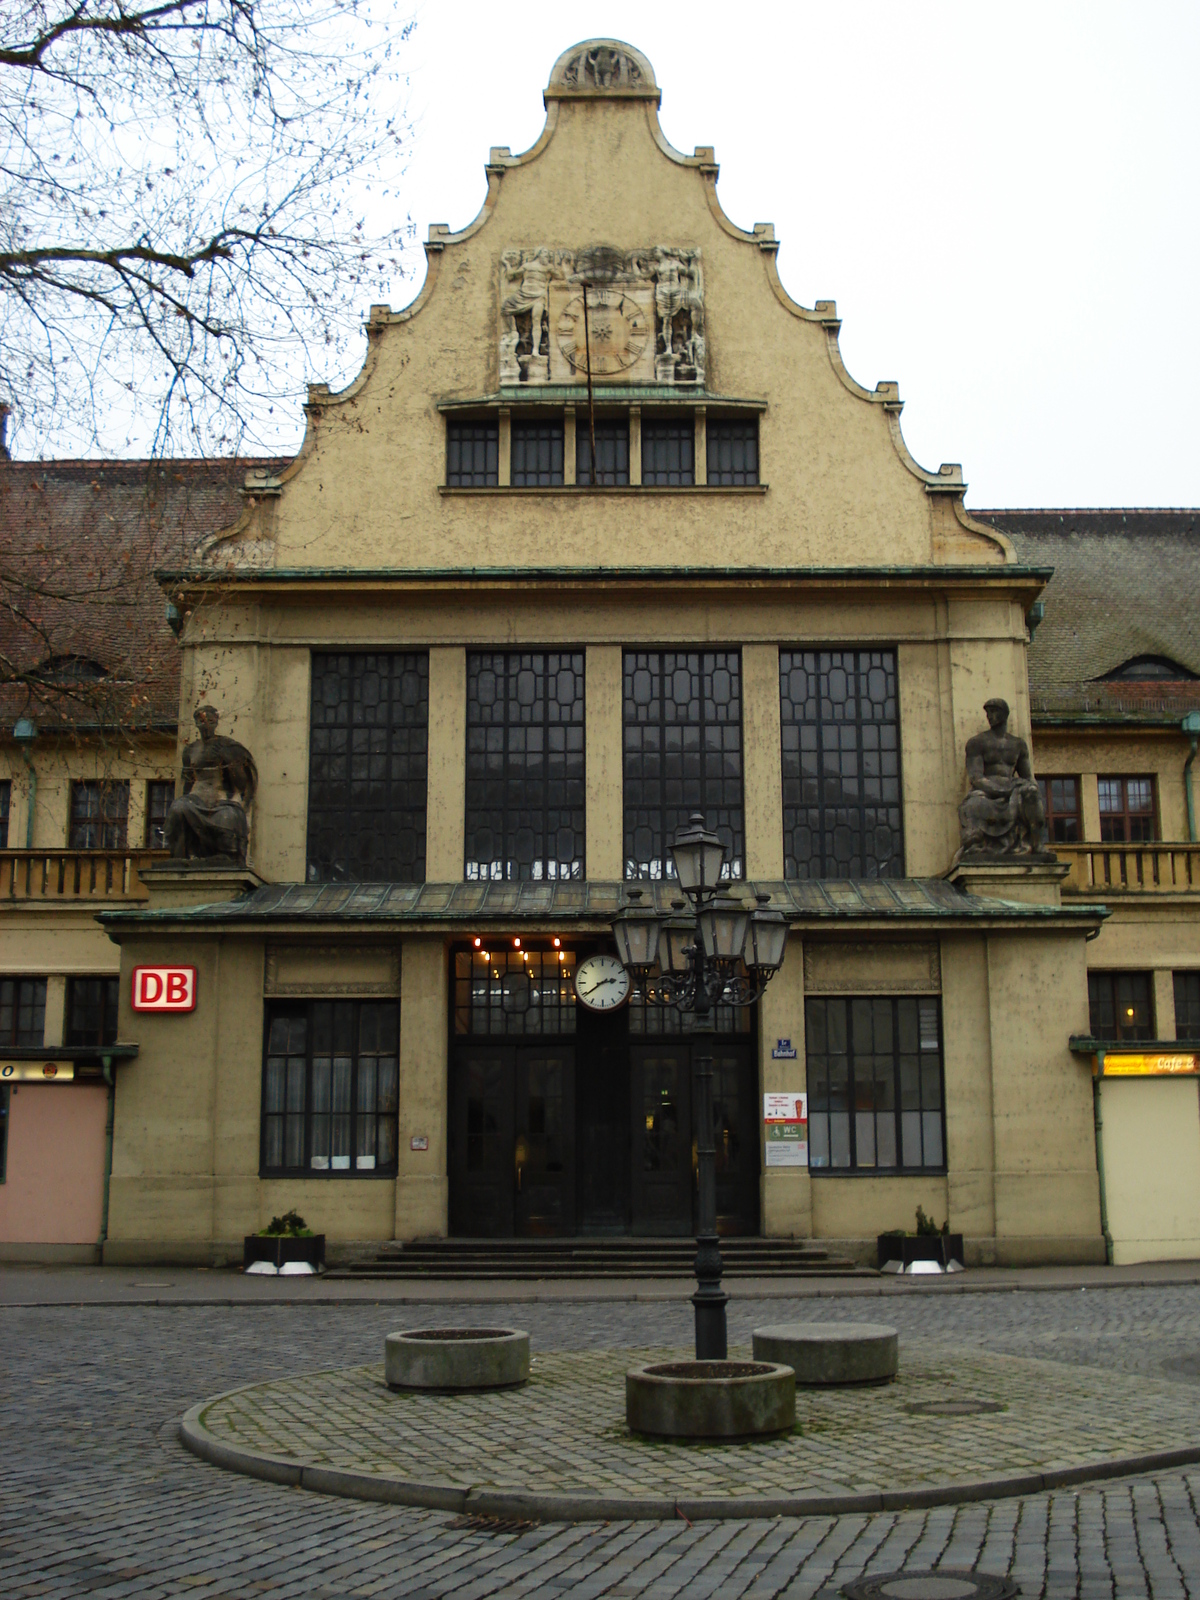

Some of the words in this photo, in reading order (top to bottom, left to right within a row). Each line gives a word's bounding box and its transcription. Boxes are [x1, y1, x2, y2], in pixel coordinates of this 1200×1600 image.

[140, 972, 188, 1004] DB
[773, 1049, 796, 1057] Bahnhof
[783, 1125, 797, 1134] WC
